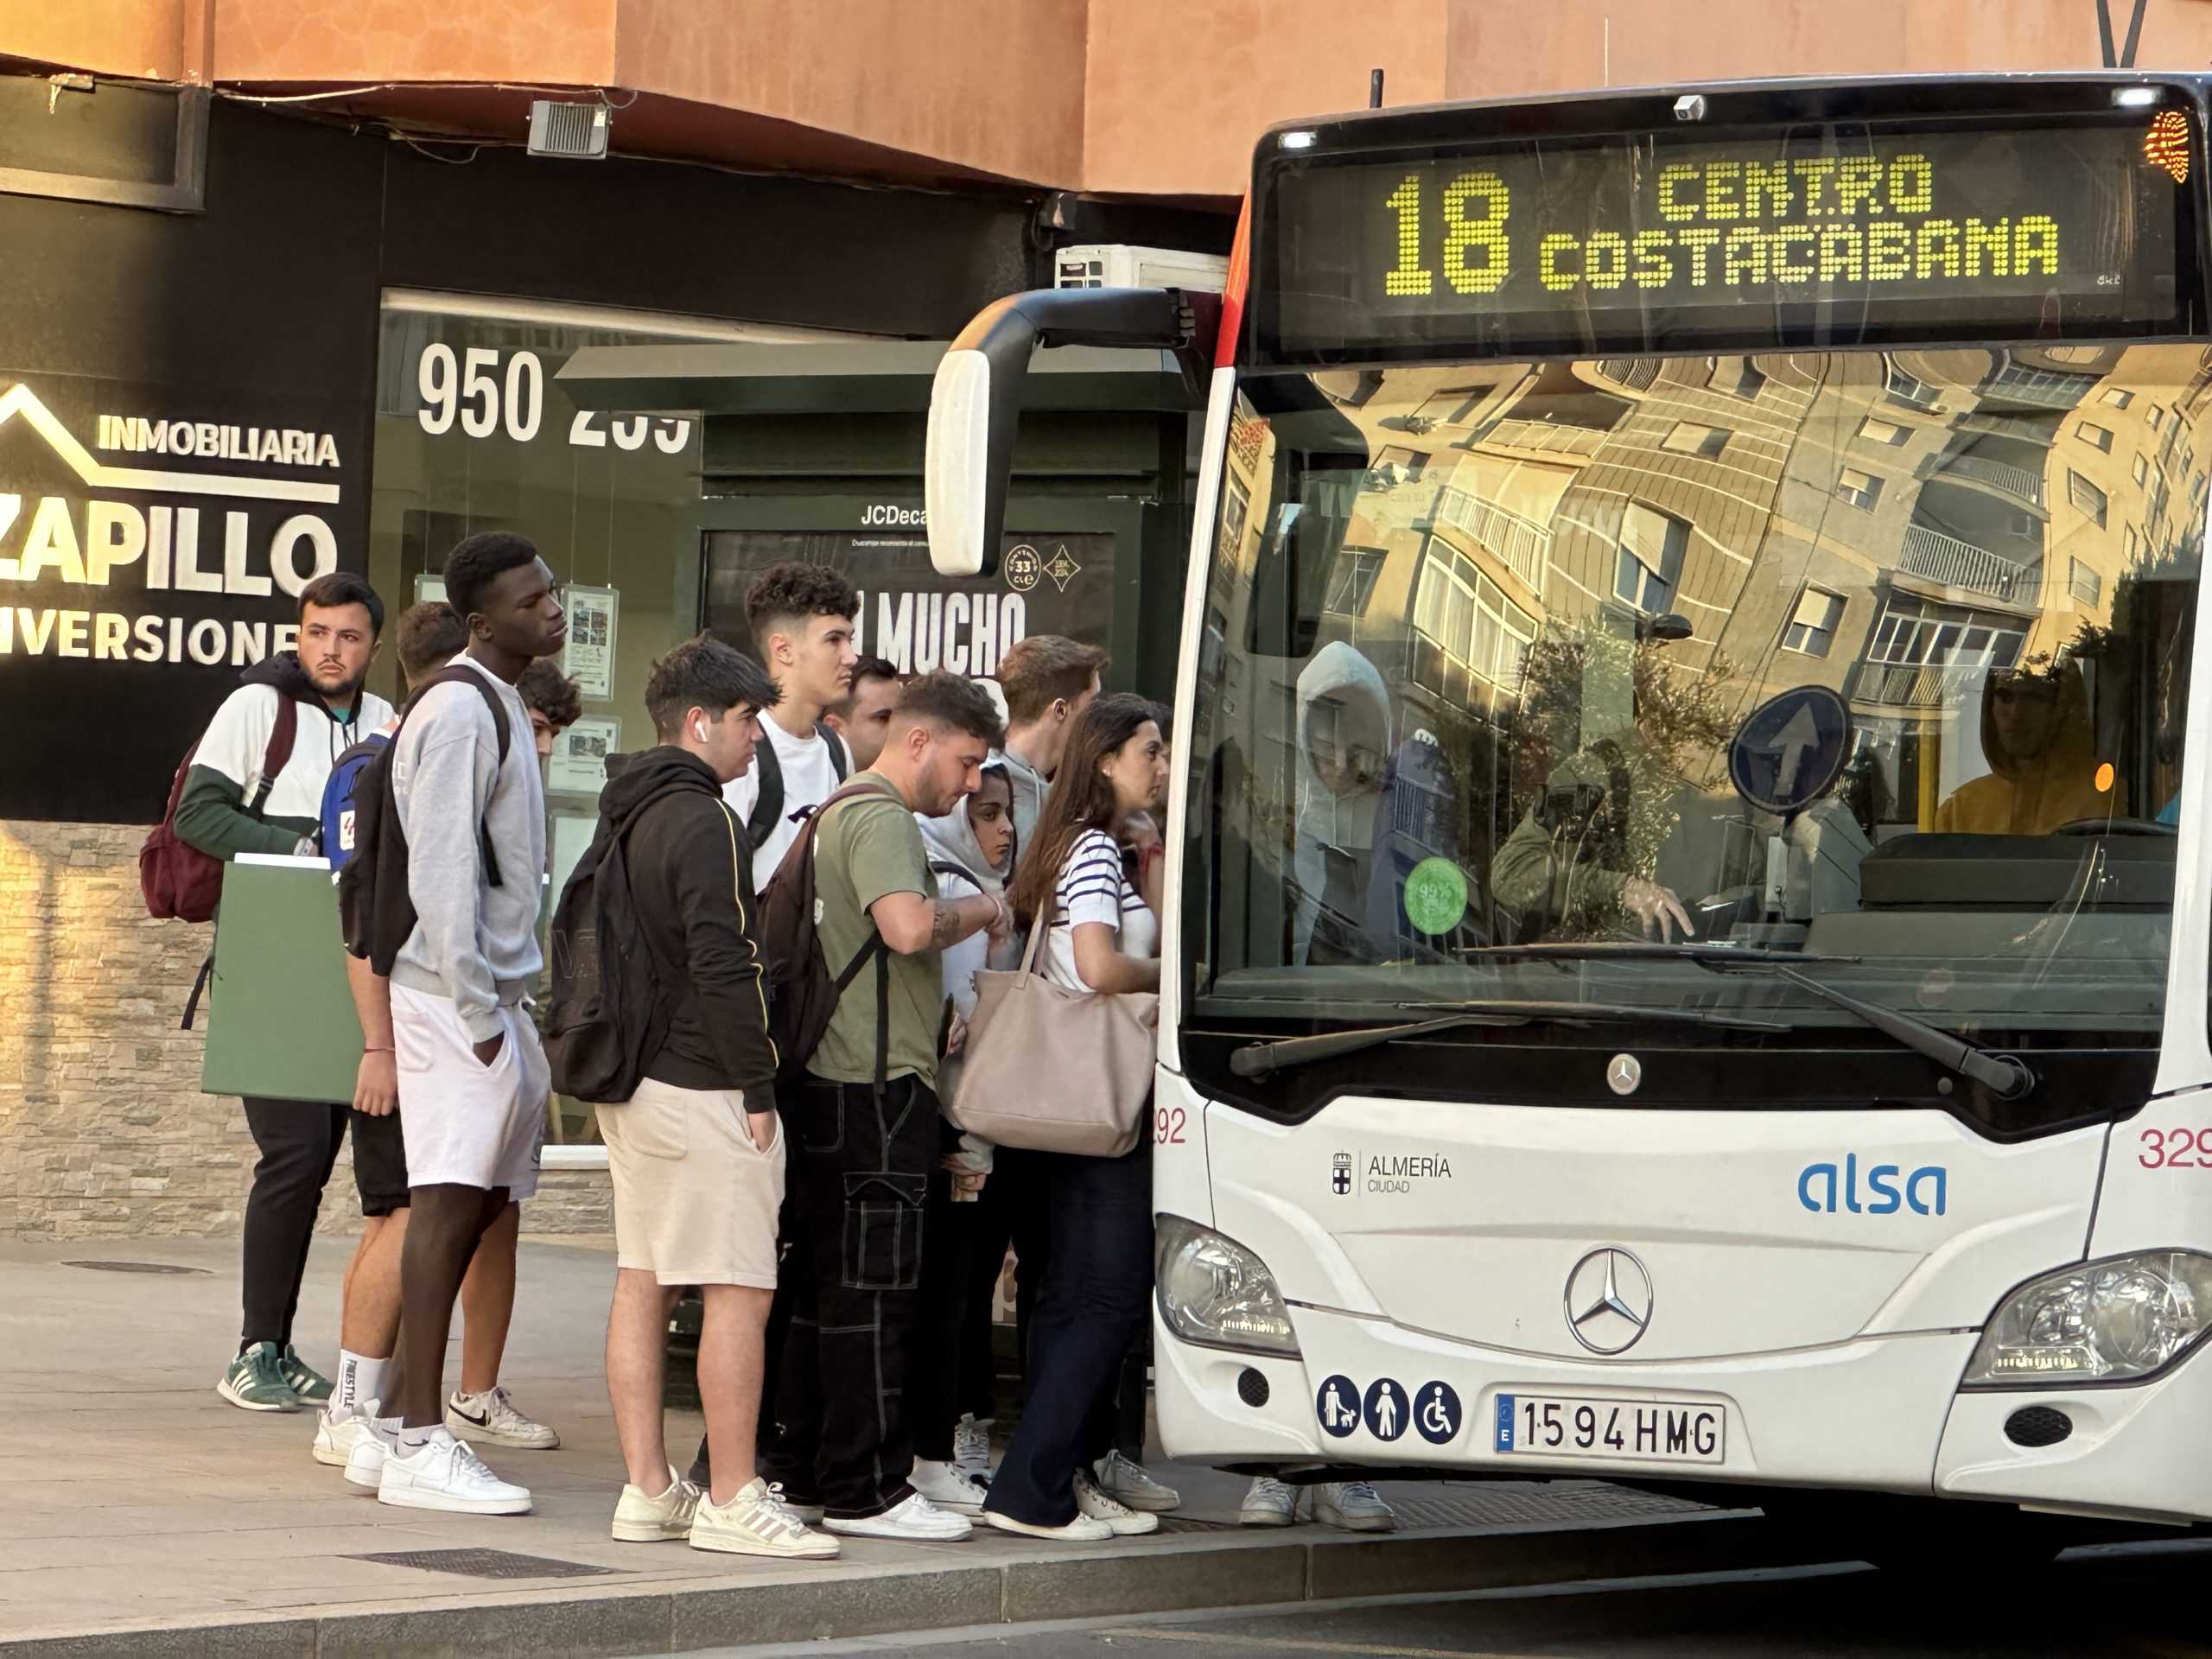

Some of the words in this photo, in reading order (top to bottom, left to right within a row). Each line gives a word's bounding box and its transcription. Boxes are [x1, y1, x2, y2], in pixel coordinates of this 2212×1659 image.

[1658, 155, 1932, 222] CENTRO
[1385, 172, 1510, 295] 18
[1540, 216, 2059, 290] COSTACABANA
[418, 342, 543, 442] 950
[98, 414, 341, 467] INMOBILIARIA
[1014, 560, 1032, 573] 33
[877, 592, 1026, 676] MUCHO
[1154, 1107, 1186, 1145] 92
[2139, 1128, 2212, 1169] 329
[1367, 1179, 1411, 1194] CIUDAD
[1368, 1153, 1452, 1179] ALMERÍA
[1797, 1152, 1947, 1217] alsa
[1501, 1428, 1510, 1442] E
